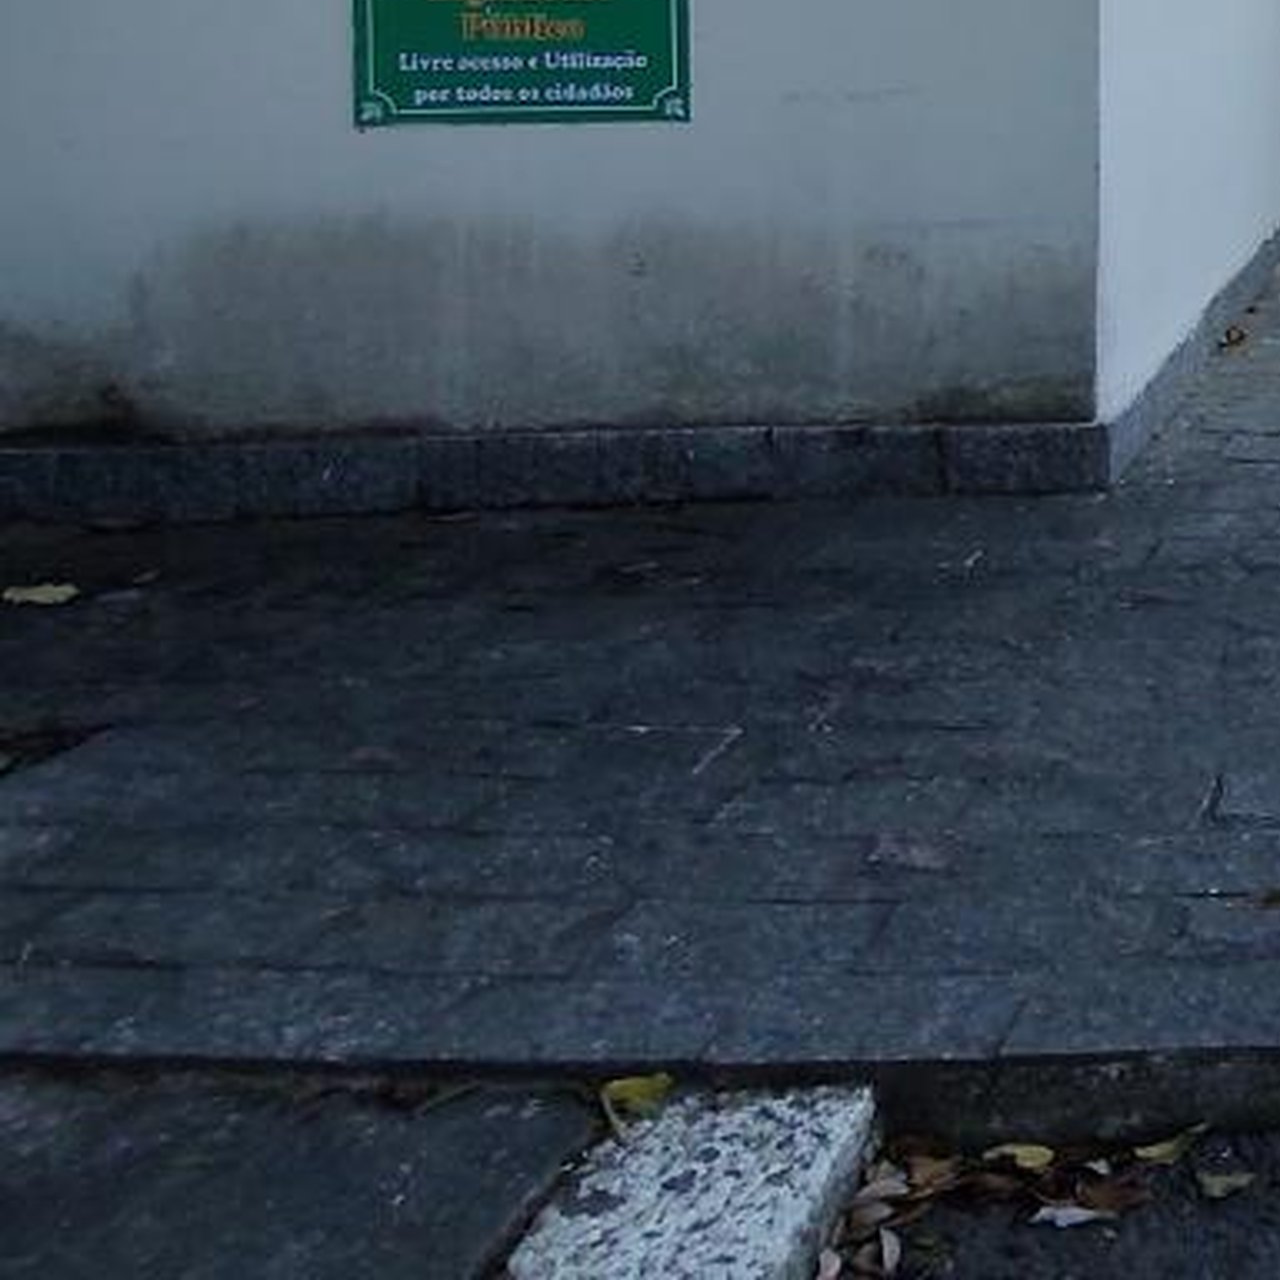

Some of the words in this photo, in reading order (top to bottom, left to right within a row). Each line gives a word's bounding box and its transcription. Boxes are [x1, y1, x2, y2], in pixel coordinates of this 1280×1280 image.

[399, 52, 454, 71] Livre
[544, 49, 649, 72] Utilização
[414, 86, 451, 106] por
[456, 84, 514, 102] todos
[518, 88, 540, 103] os
[544, 81, 635, 102] cidadãos
